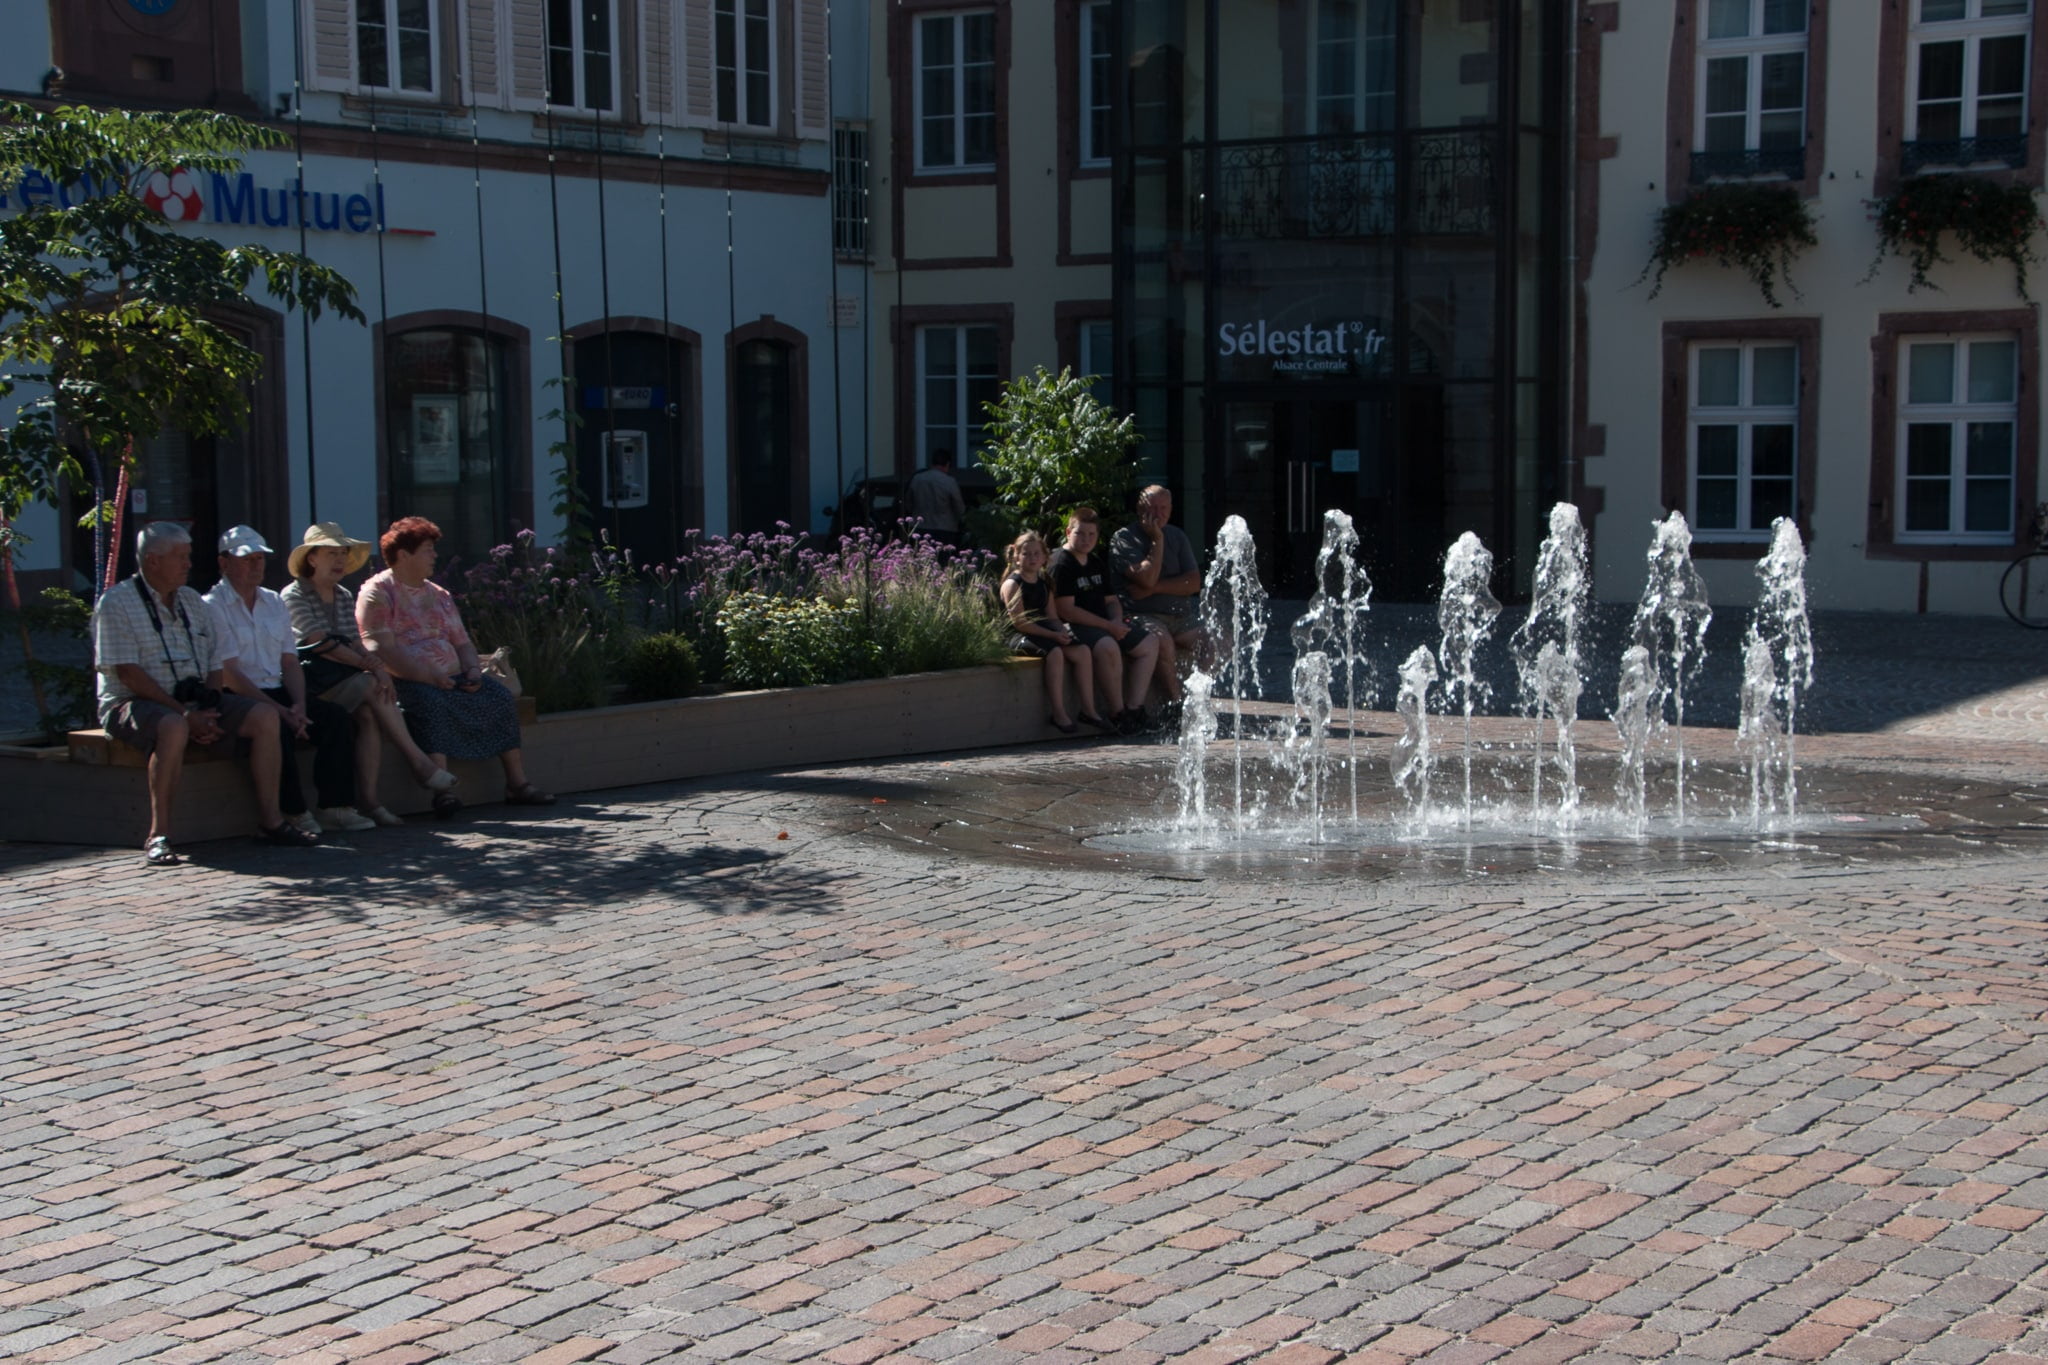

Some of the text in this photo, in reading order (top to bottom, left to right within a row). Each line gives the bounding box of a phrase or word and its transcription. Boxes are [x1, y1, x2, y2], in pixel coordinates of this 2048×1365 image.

[212, 172, 385, 233] Mutuel
[1272, 358, 1348, 370] Alsace Centrale
